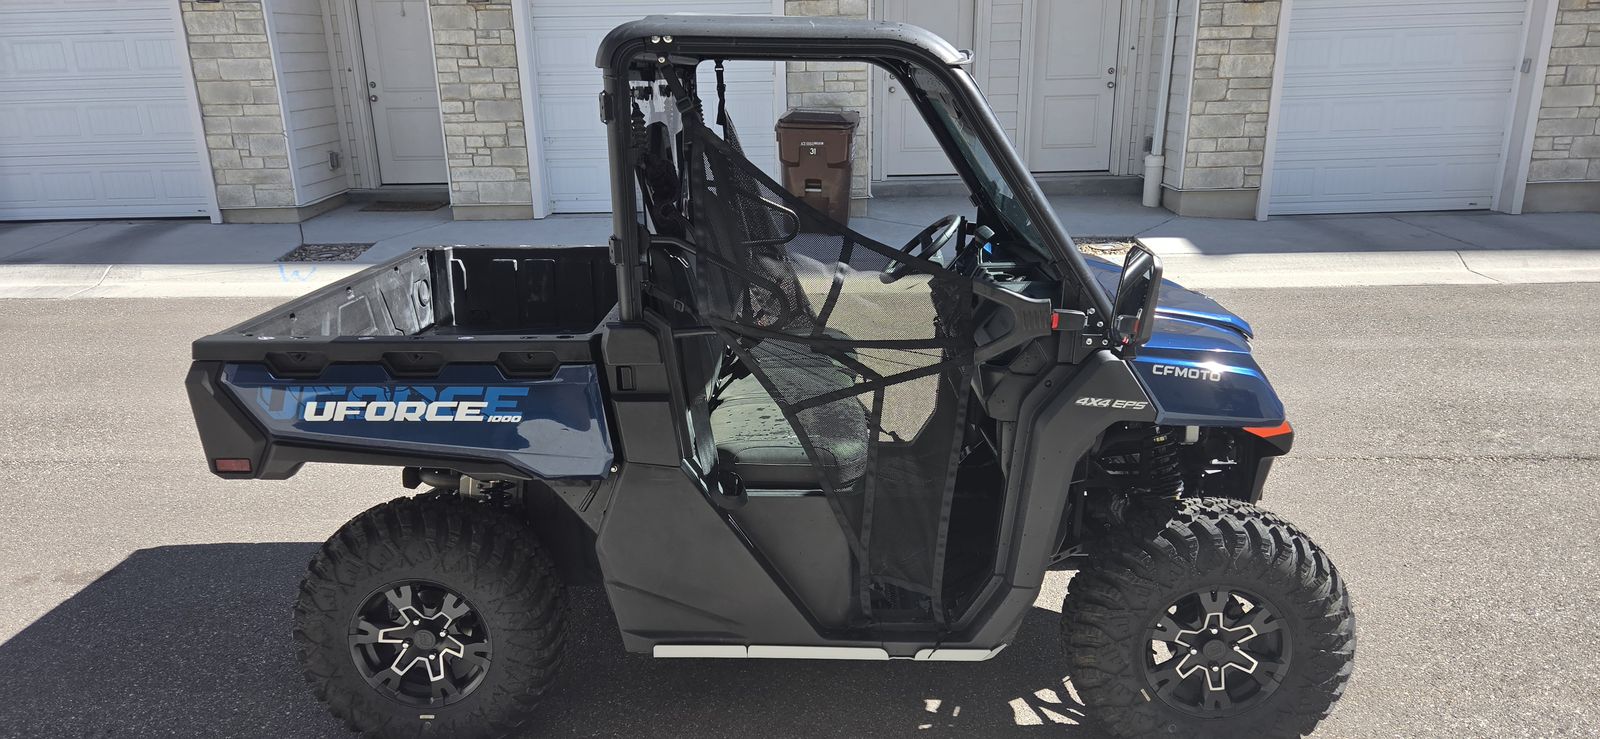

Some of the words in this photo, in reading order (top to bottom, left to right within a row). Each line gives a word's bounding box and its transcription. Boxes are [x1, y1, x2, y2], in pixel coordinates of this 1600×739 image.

[1152, 364, 1221, 382] CFMOTO
[303, 401, 488, 421] UFORCE
[1075, 397, 1110, 408] 4X4
[1111, 399, 1149, 410] EPS
